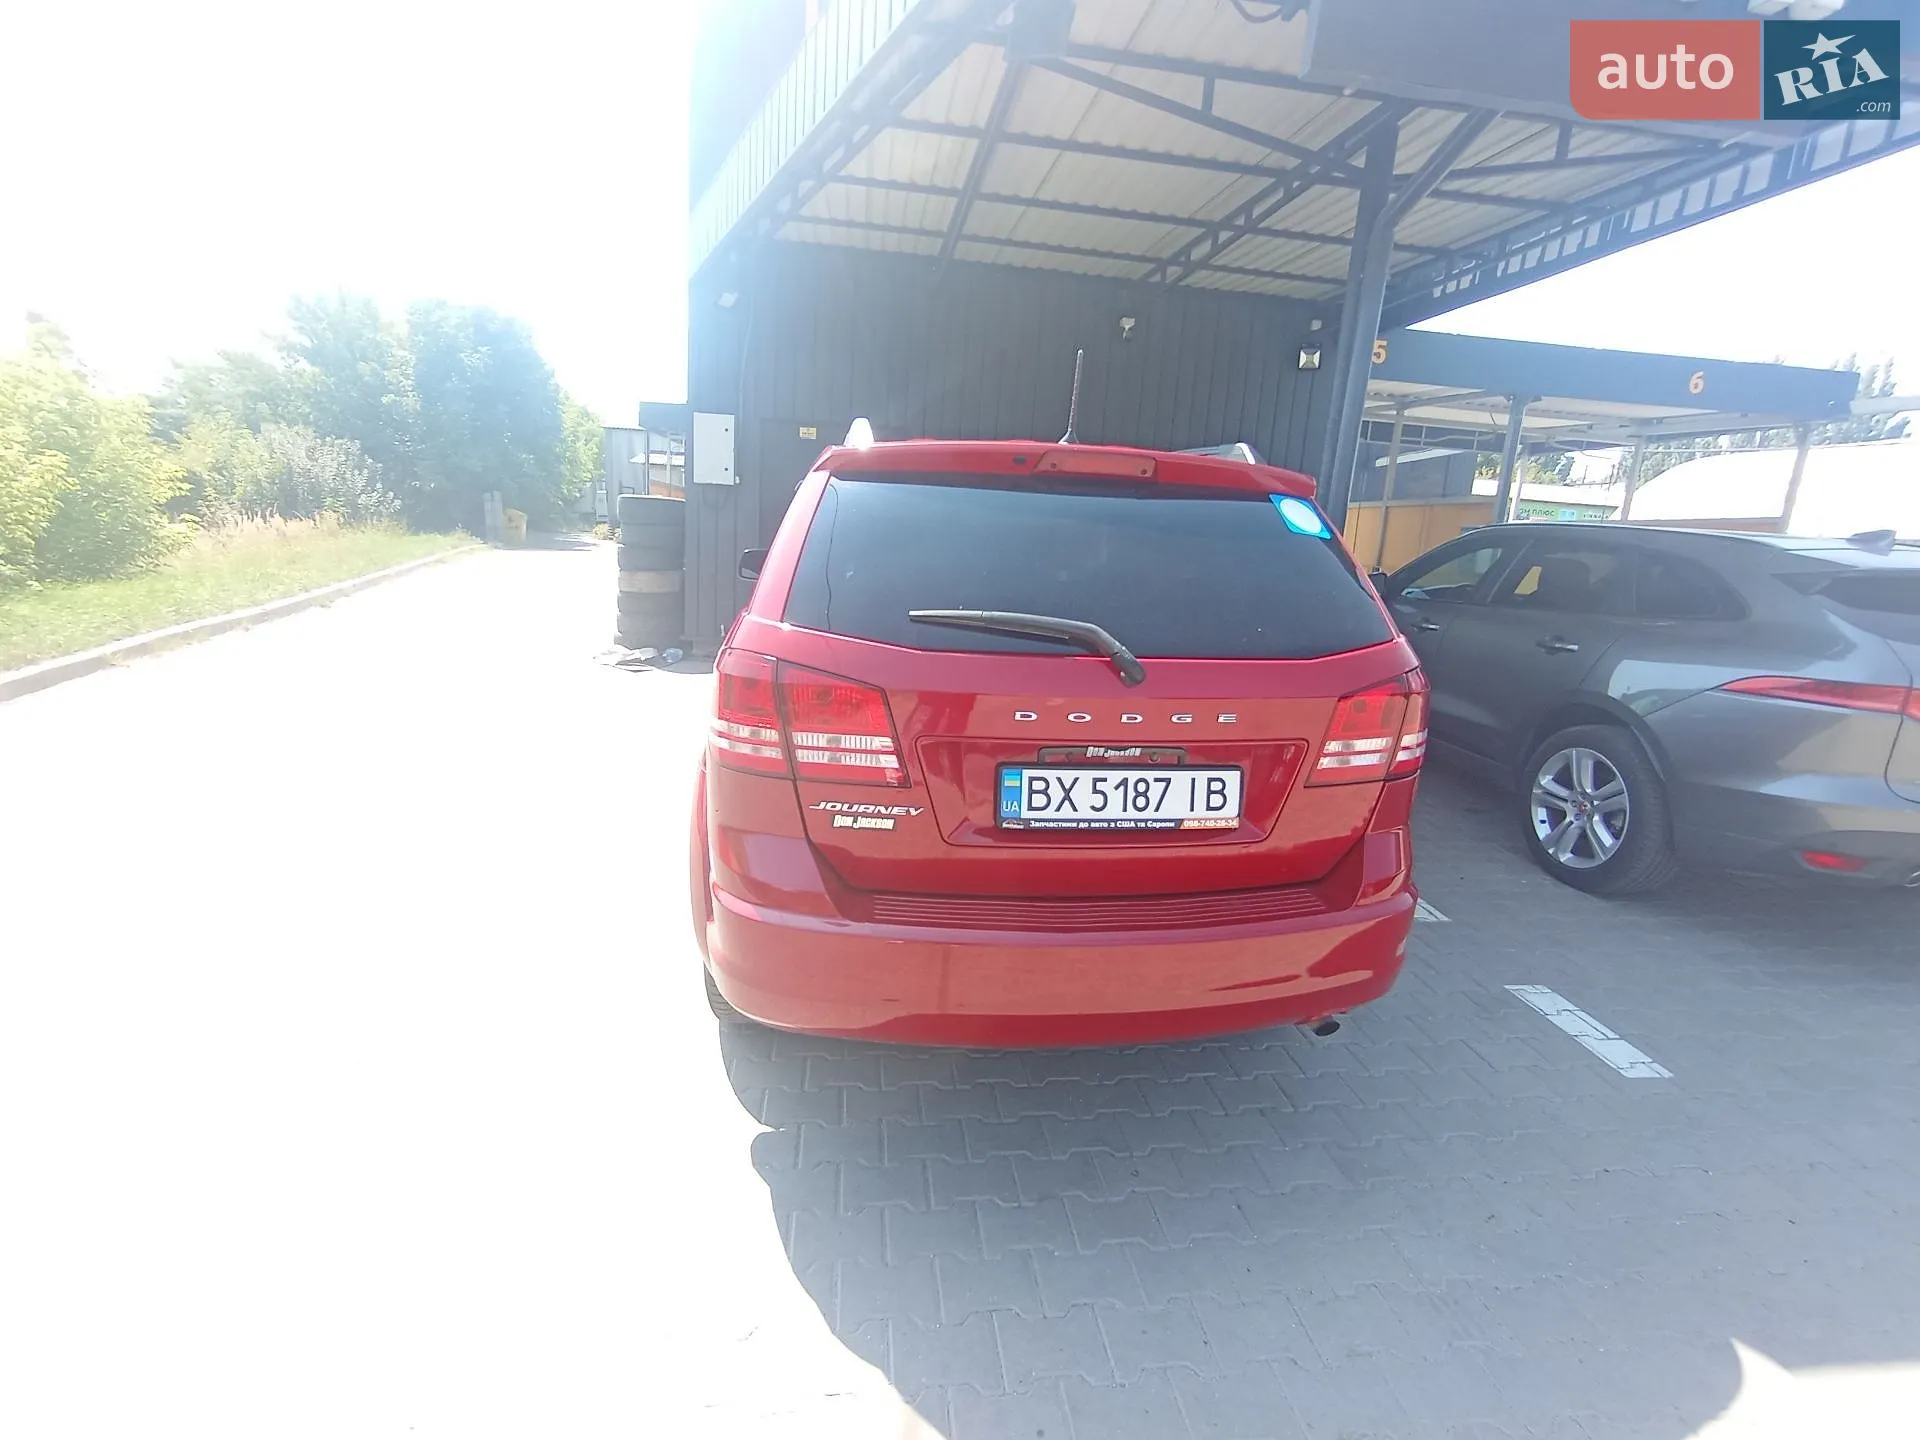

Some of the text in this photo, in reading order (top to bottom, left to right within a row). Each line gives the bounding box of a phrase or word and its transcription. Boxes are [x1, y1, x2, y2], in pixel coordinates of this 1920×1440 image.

[1372, 340, 1387, 364] 5
[1689, 371, 1704, 394] 6
[1014, 711, 1237, 723] DODGE
[1027, 776, 1228, 813] BX 5187 IB
[809, 801, 925, 816] JOURNEY
[1002, 800, 1020, 813] UA
[1029, 820, 1077, 828] Запчастини
[1078, 821, 1089, 829] до
[1116, 820, 1135, 828] США
